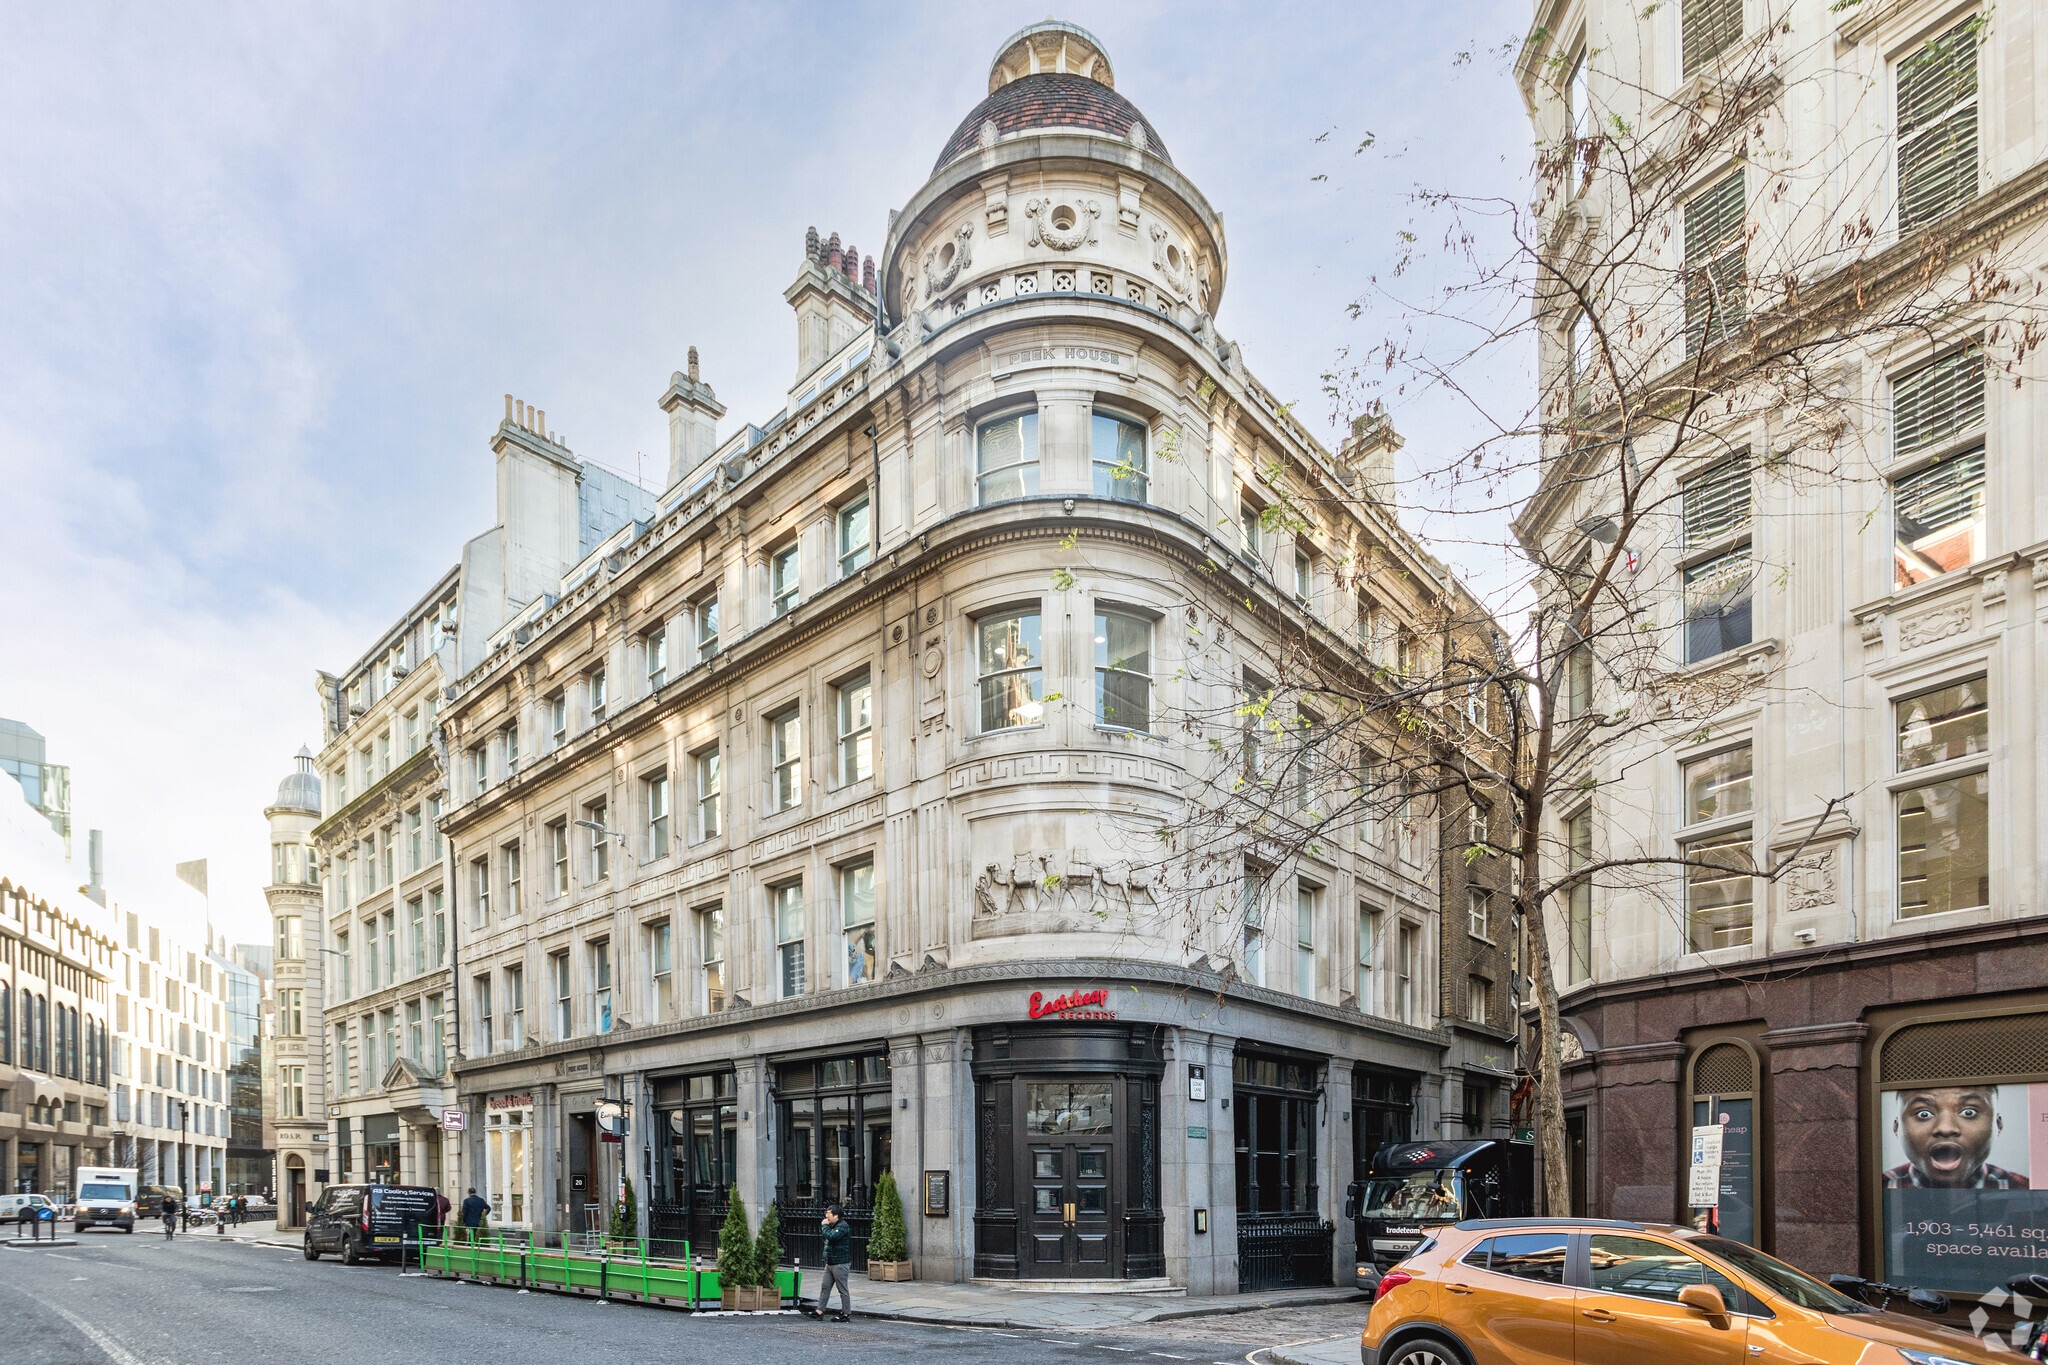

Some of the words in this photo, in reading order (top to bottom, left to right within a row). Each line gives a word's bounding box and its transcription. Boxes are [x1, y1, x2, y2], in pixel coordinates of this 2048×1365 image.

[1009, 348, 1056, 365] PEEK
[1064, 347, 1120, 366] HOUSE
[1028, 988, 1109, 1019] Eastcheap
[1059, 1010, 1117, 1020] RECORDS
[1386, 1226, 1421, 1234] tradeteam
[1906, 1221, 1952, 1237] 1,903
[1968, 1223, 2016, 1239] 5,461
[1926, 1243, 1983, 1256] space
